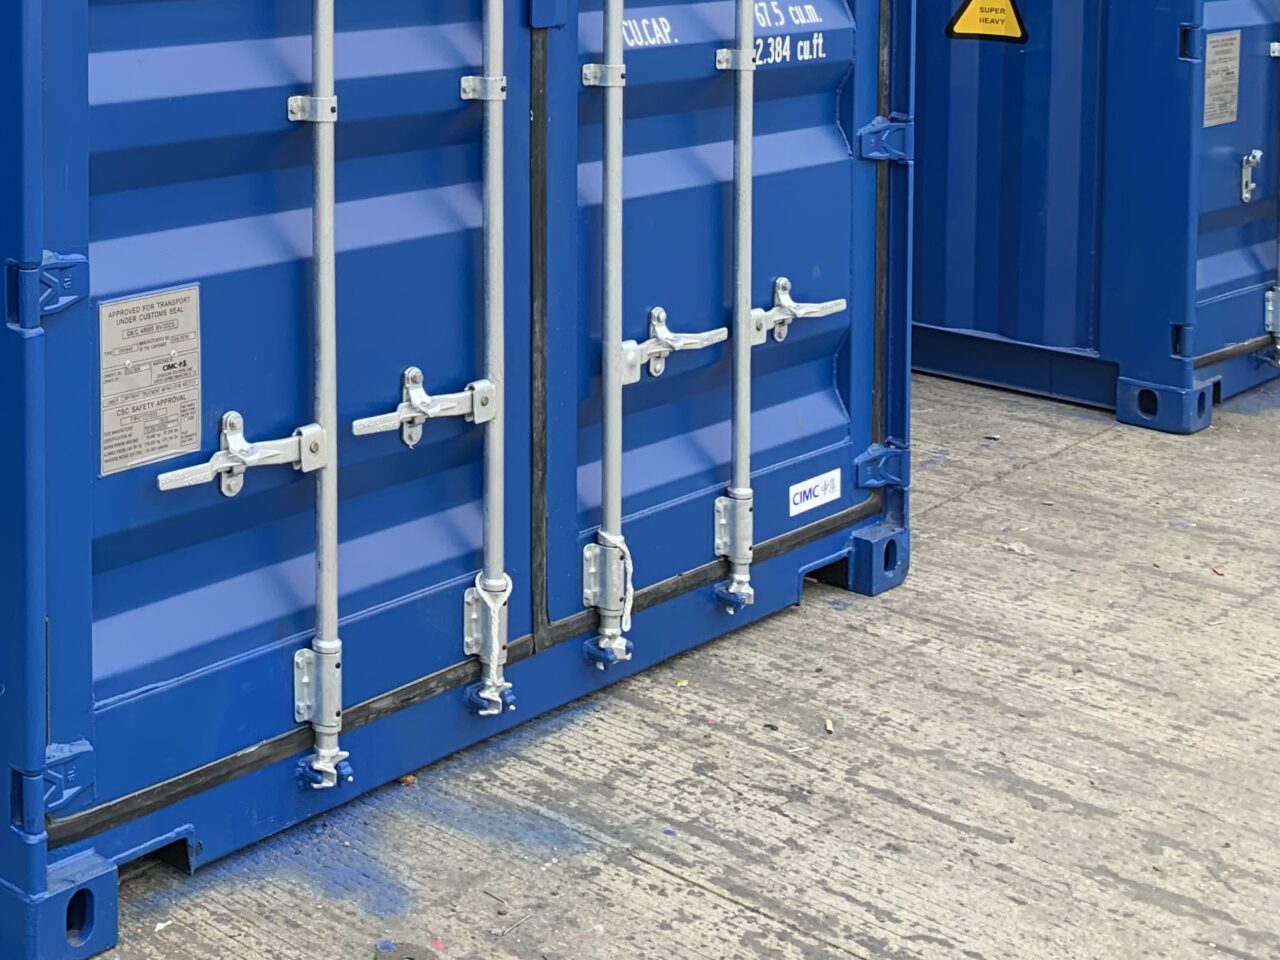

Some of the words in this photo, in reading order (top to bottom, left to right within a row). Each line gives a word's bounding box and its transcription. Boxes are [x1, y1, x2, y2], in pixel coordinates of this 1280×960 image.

[980, 6, 1006, 14] SUPER
[622, 17, 679, 47] CU.CAP.
[754, 1, 784, 28] 67.5
[788, 4, 823, 25] cu.m.
[756, 35, 790, 65] 2,384
[797, 32, 826, 61] cu.ft.
[108, 306, 140, 318] APPROVED
[142, 303, 154, 312] FOR
[157, 296, 191, 307] TRANSPORT
[116, 314, 139, 326] UNDER
[139, 310, 166, 321] CUSTOMS
[170, 306, 184, 315] SEAL
[116, 408, 130, 416] CSC
[132, 402, 154, 413] SAFETY
[156, 394, 186, 406] APPROVAL
[792, 484, 819, 506] CIMC
